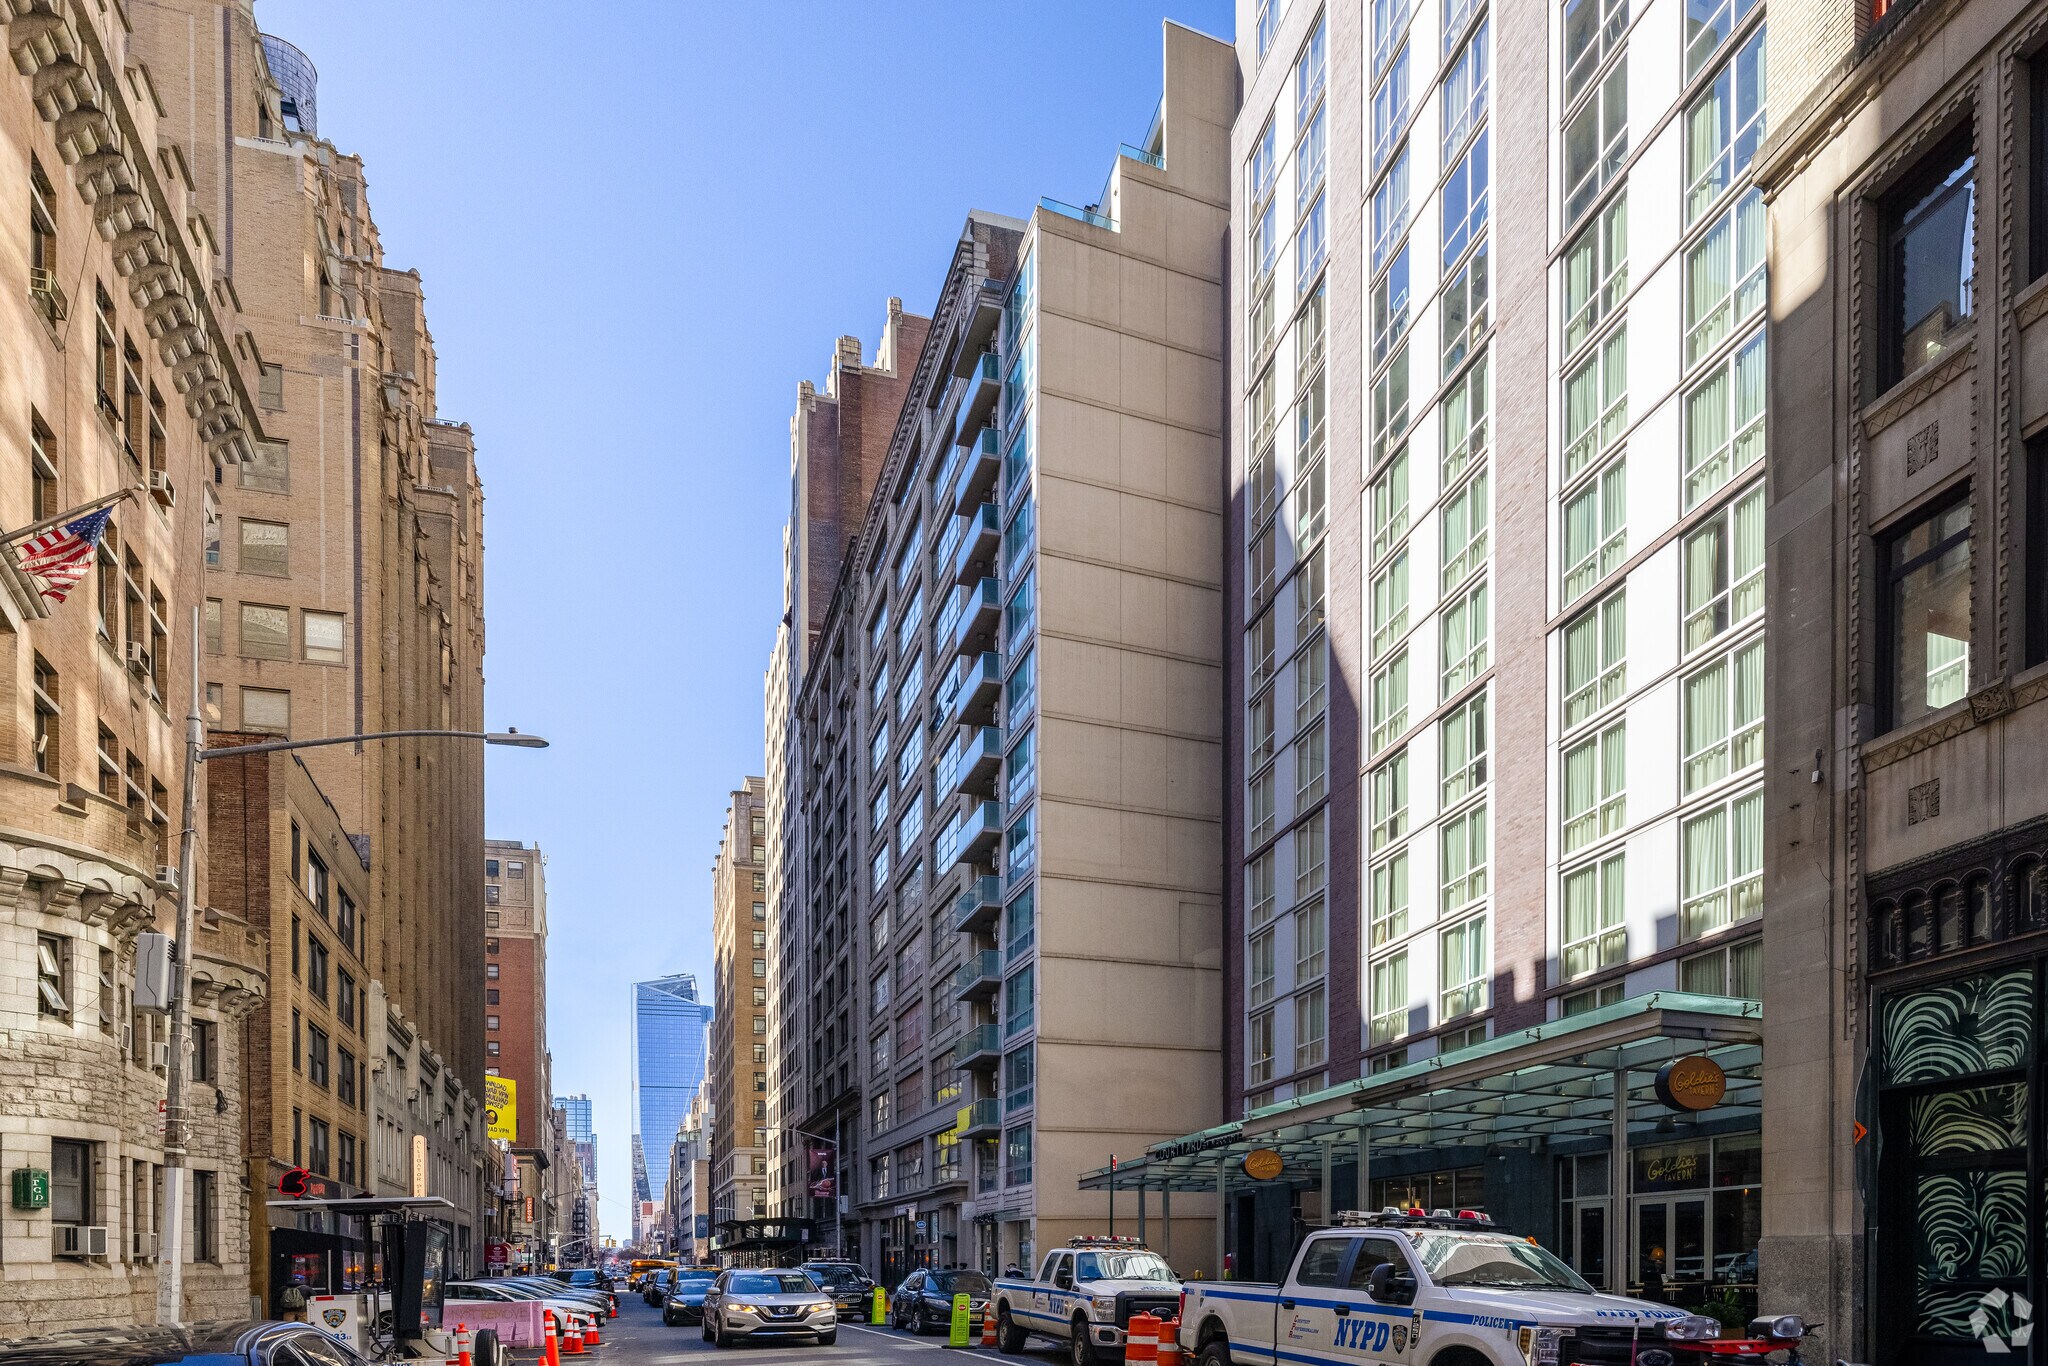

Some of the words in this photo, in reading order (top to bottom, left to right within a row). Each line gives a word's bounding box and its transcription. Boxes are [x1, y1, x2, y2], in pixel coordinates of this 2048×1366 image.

[1674, 1071, 1720, 1092] Goldie's
[486, 1100, 503, 1111] OWSER
[1155, 1140, 1202, 1161] COURTYARD
[1472, 1315, 1505, 1329] POLICE
[1333, 1318, 1390, 1352] NYPD
